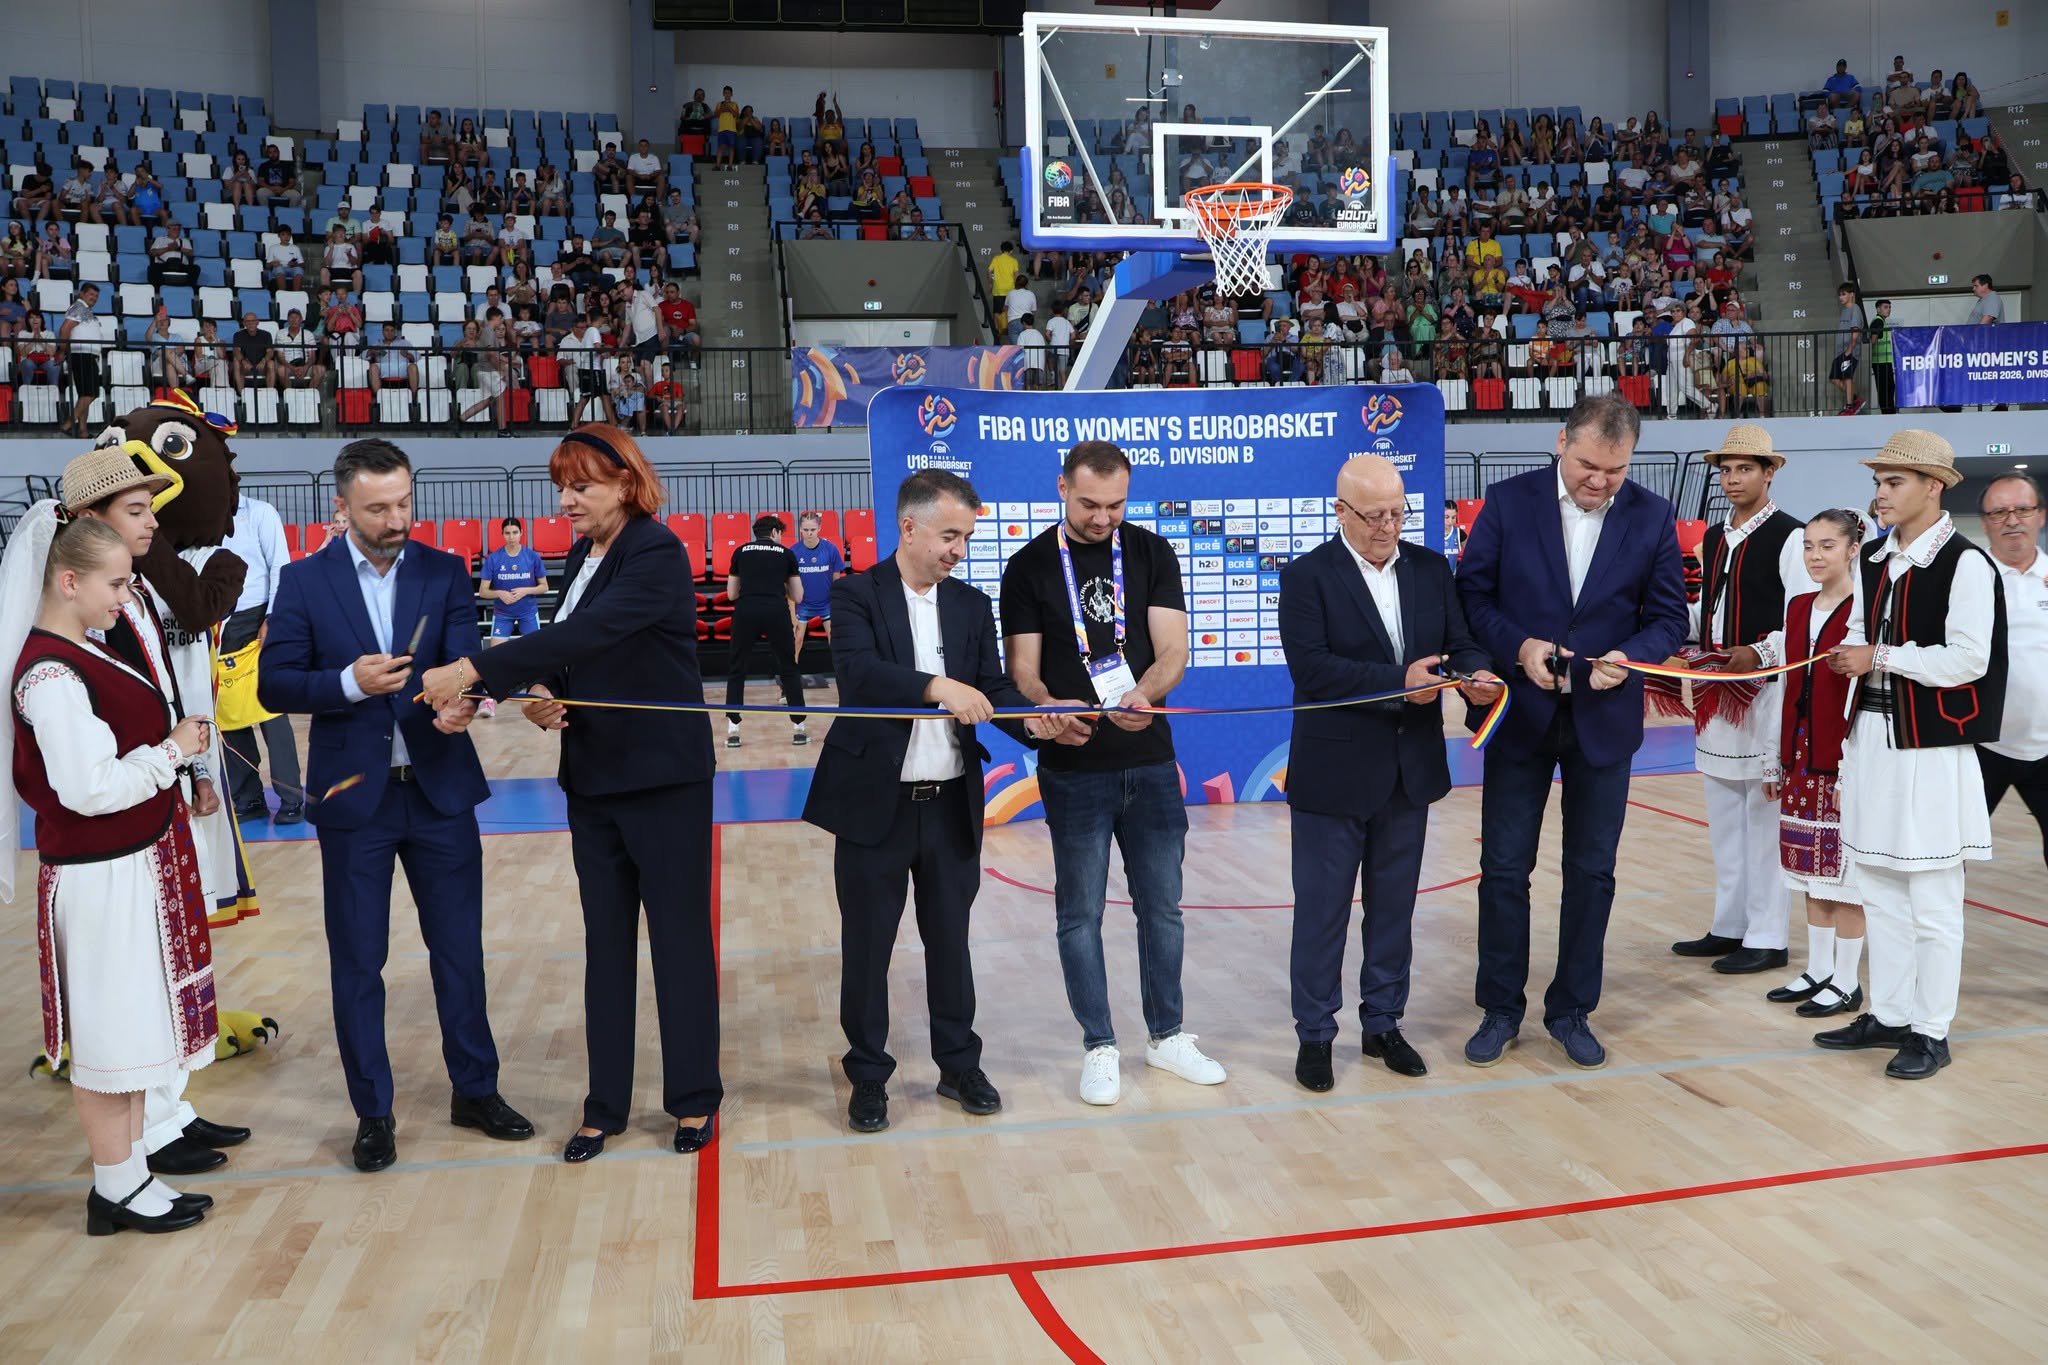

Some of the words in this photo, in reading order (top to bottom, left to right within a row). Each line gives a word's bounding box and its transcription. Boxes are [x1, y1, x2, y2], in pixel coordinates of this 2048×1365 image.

[2008, 105, 2024, 113] R12
[2023, 139, 2040, 147] R10
[2035, 162, 2048, 170] R9
[1772, 180, 1784, 188] R9
[727, 200, 739, 208] R9
[1048, 196, 1070, 207] FIBA
[1776, 203, 1788, 211] R8
[1337, 210, 1376, 221] YOUTH
[727, 223, 739, 231] R8
[972, 224, 984, 232] R8
[1337, 221, 1376, 230] EUROBASKET
[1780, 227, 1792, 236] R7
[728, 247, 740, 256] R7
[981, 247, 992, 256] R7
[1784, 253, 1797, 262] R6
[729, 273, 742, 282] R6
[1789, 282, 1802, 290] R5
[730, 301, 743, 310] R5
[1793, 309, 1806, 319] R4
[731, 329, 744, 338] R4
[1797, 339, 1811, 349] R3
[732, 360, 745, 368] R3
[1902, 355, 1935, 371] FIBA
[1938, 353, 1963, 369] U18
[1966, 350, 2039, 368] WOMEN'S
[1803, 373, 1815, 383] R2
[2000, 370, 2024, 380] 2026,
[2026, 369, 2048, 379] DIVIS
[733, 392, 747, 401] R2
[978, 415, 1026, 441] FIBA
[1031, 417, 1070, 442] U18
[1073, 415, 1183, 442] WOMEN'S
[1188, 411, 1338, 441] EUROBASKET
[933, 445, 947, 453] FIBA
[1376, 442, 1390, 450] FIBA
[1170, 446, 1239, 465] DIVISION
[1243, 446, 1254, 464] B
[907, 454, 929, 470] U18
[929, 460, 973, 470] EUROBASKET
[1127, 506, 1144, 515] BCR
[1161, 524, 1178, 533] BCR
[742, 545, 784, 553] AZERBAIJAN
[970, 544, 998, 553] molten
[1194, 542, 1211, 551] BCR
[1228, 560, 1245, 569] BCR
[497, 571, 531, 581] AZERBAIJAN
[1262, 578, 1279, 587] BCR
[1265, 596, 1278, 604] h2
